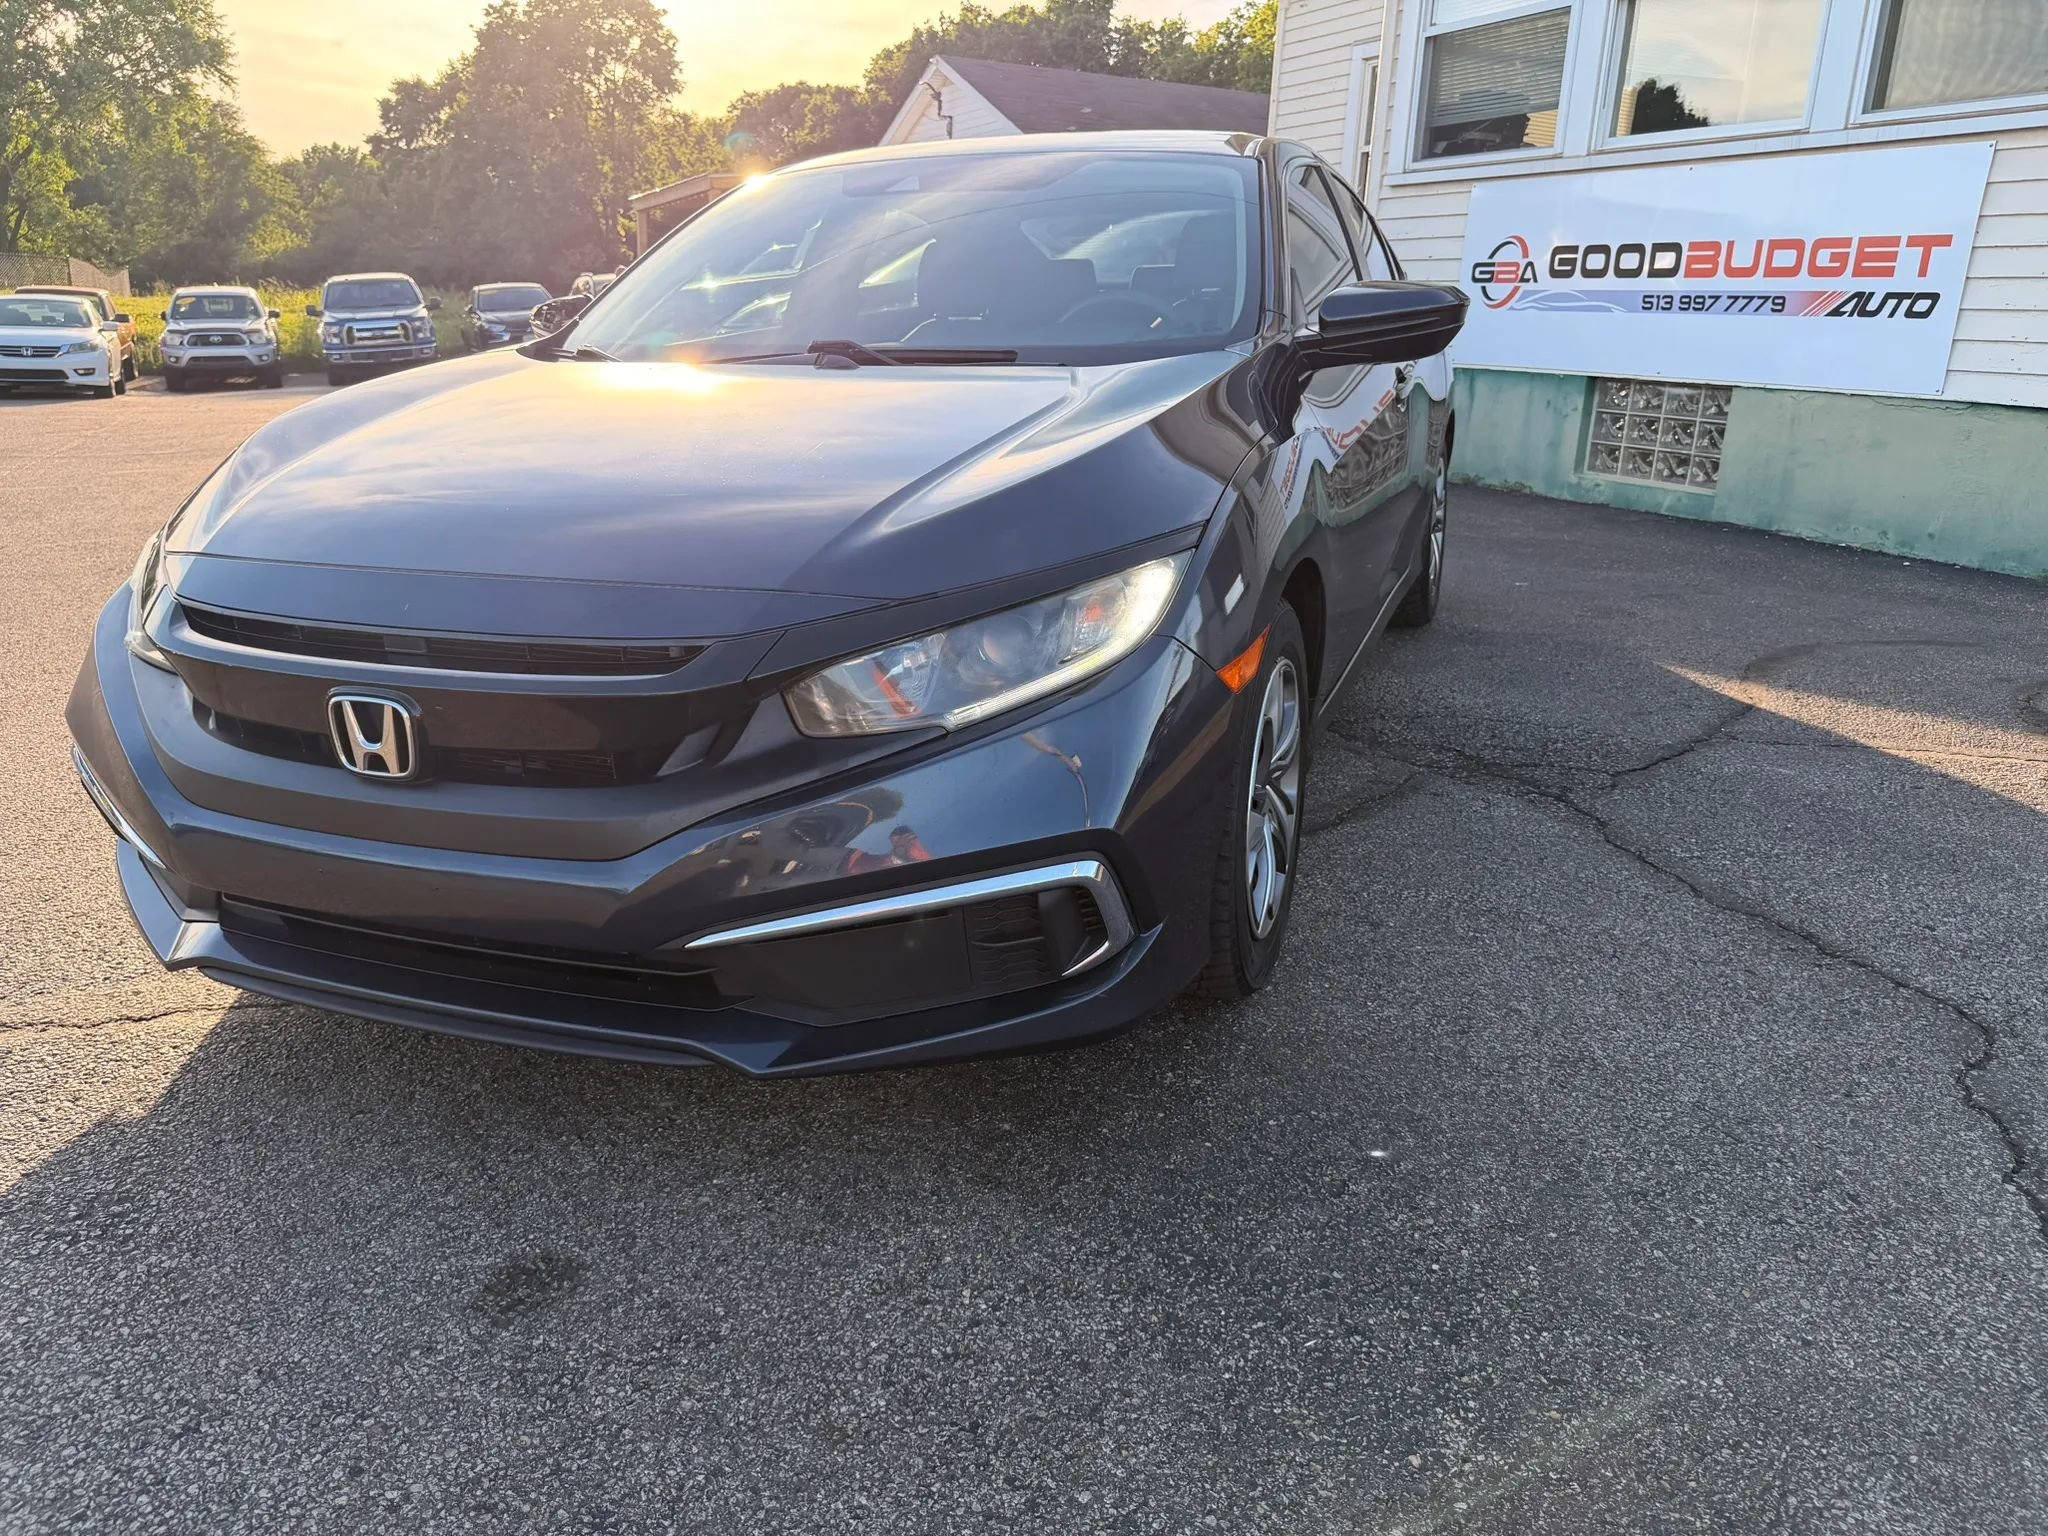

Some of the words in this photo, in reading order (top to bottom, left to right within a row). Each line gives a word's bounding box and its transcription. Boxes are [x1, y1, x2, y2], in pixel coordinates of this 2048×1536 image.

[1471, 261, 1538, 283] GBA
[1641, 294, 1674, 311] 513
[1678, 295, 1721, 312] 997
[1723, 295, 1786, 313] 7779
[1824, 291, 1941, 319] AUTO
